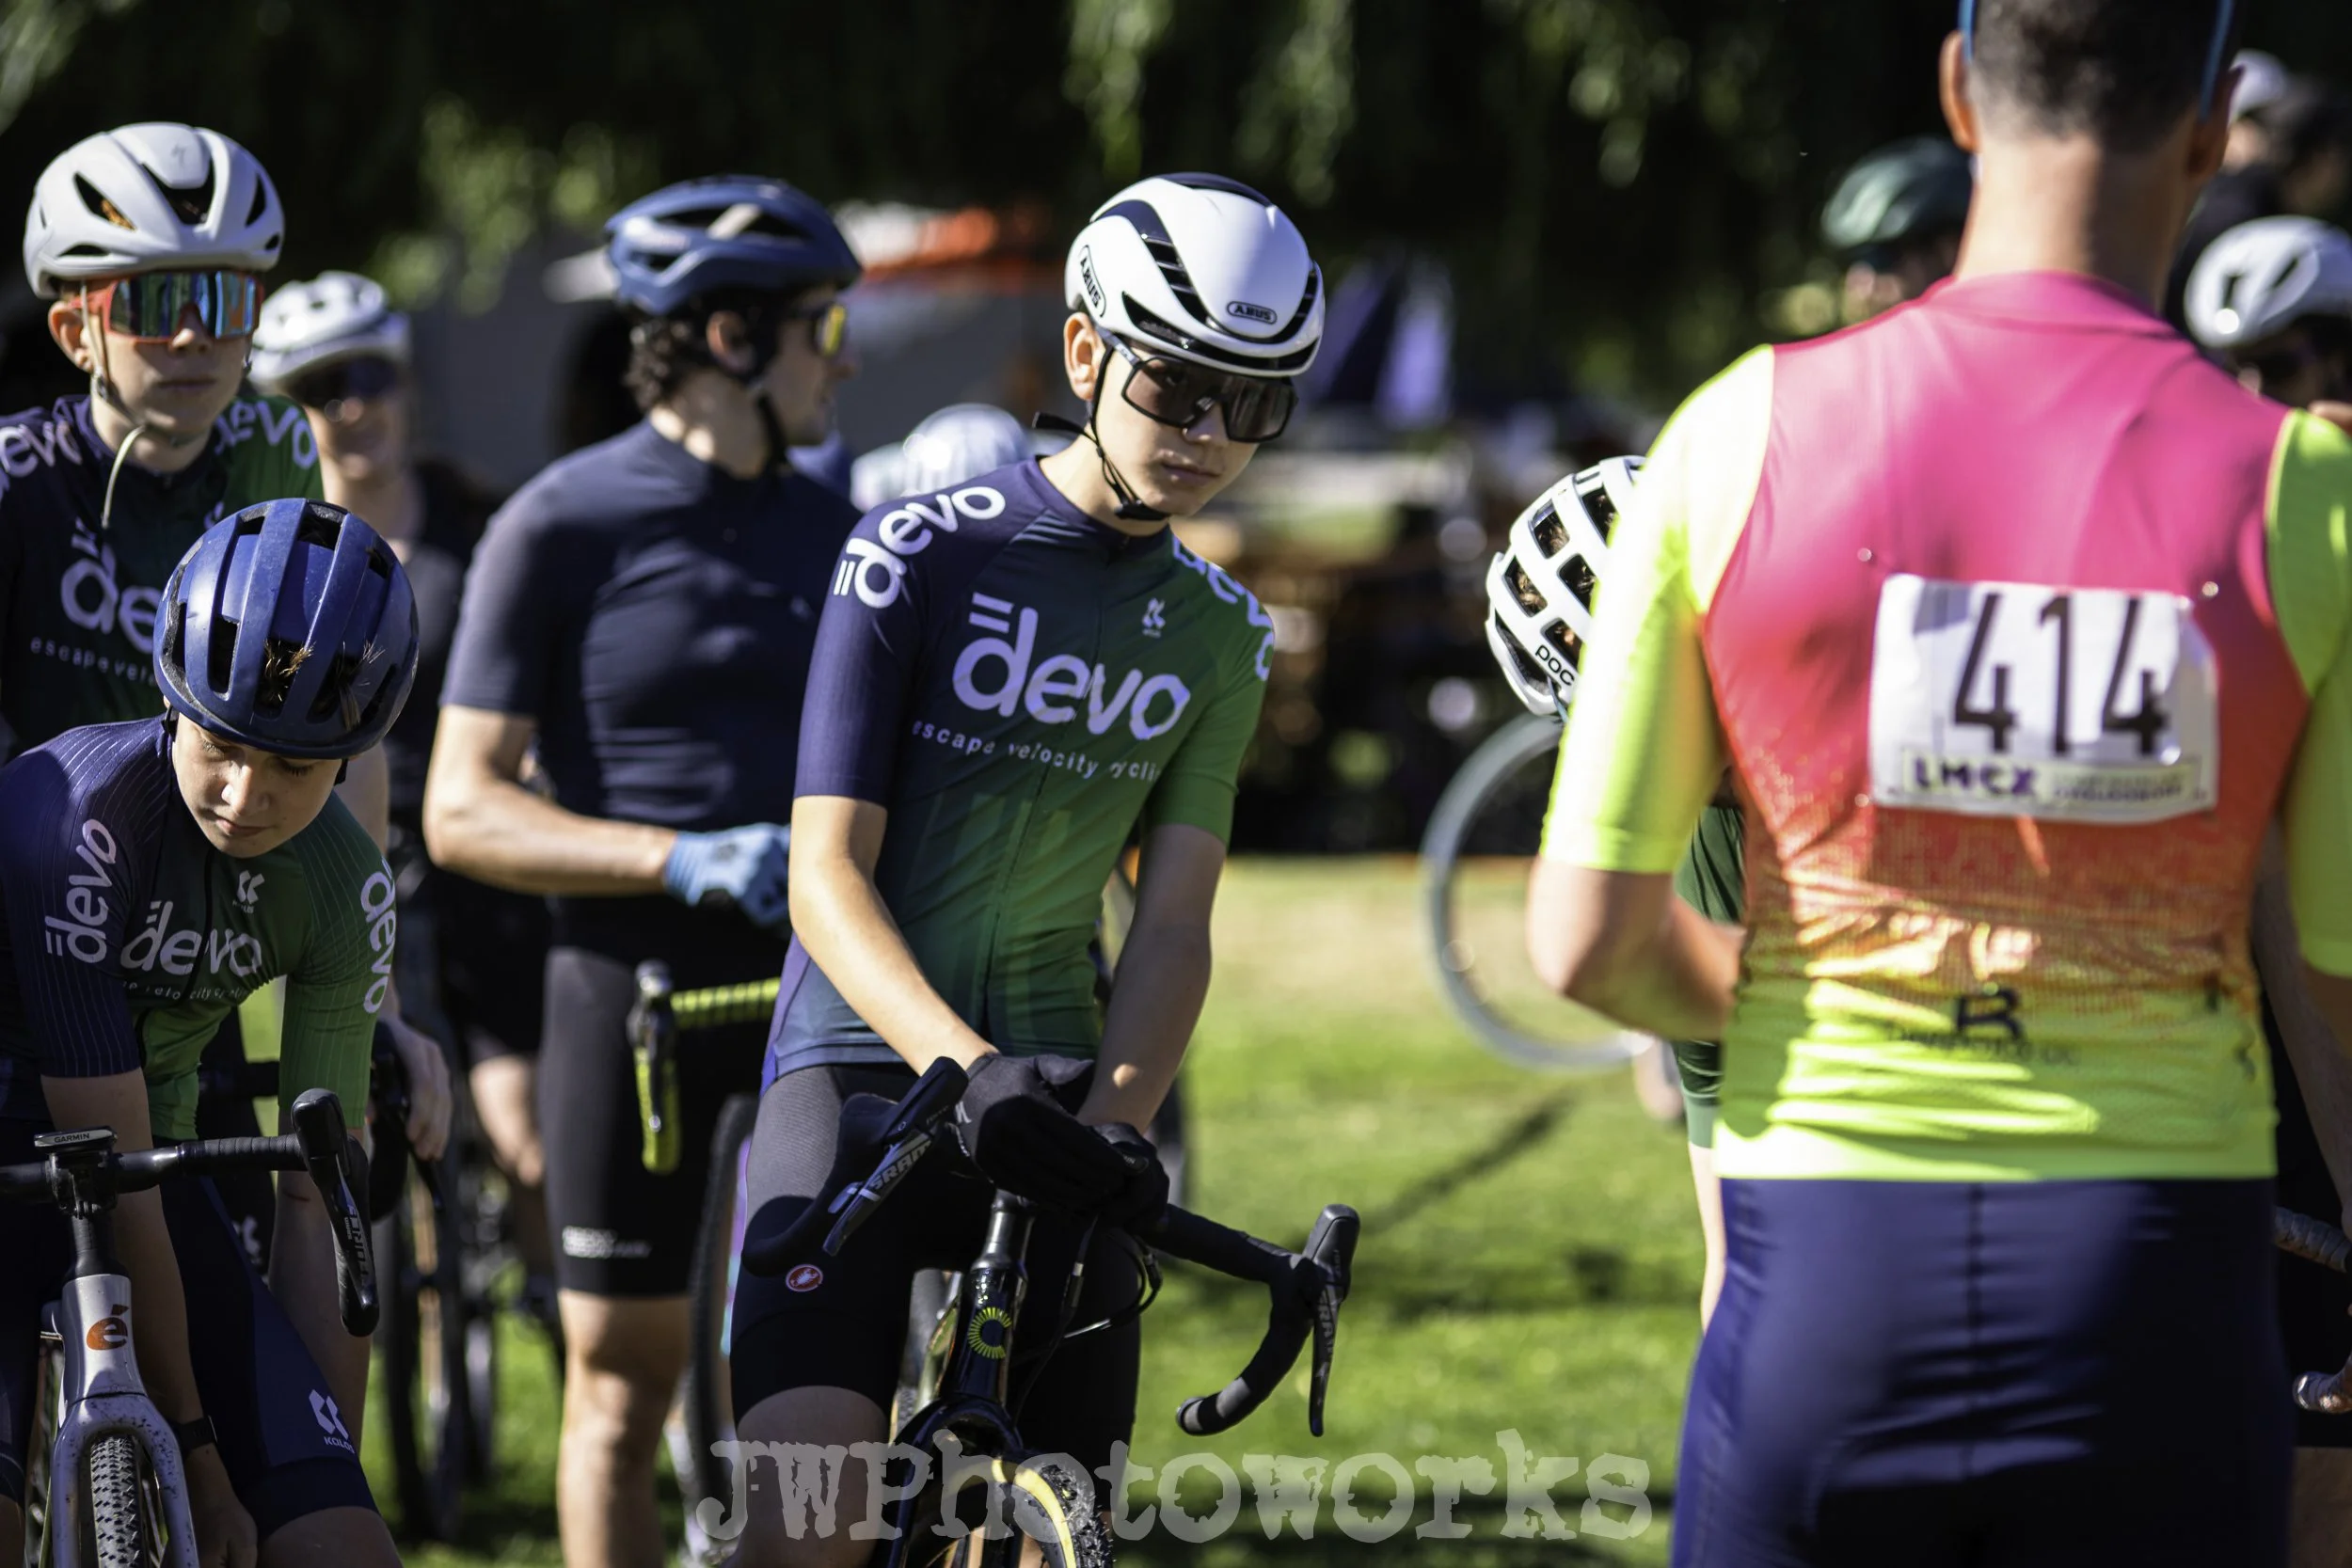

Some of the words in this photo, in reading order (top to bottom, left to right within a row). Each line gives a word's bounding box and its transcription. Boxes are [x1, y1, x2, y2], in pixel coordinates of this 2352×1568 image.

[1080, 256, 1103, 309] ABUS
[1232, 303, 1273, 322] ABUS
[834, 486, 1006, 609] devo
[952, 593, 1191, 740] devo
[1534, 644, 1576, 687] POC
[1953, 593, 2169, 756] 414
[912, 721, 995, 755] escape
[1009, 742, 1099, 779] velocity
[1915, 758, 2037, 796] LMCX
[44, 818, 117, 964] devo
[120, 900, 263, 977] devo
[54, 1132, 90, 1143] GARMIN
[869, 1140, 932, 1190] SRAM
